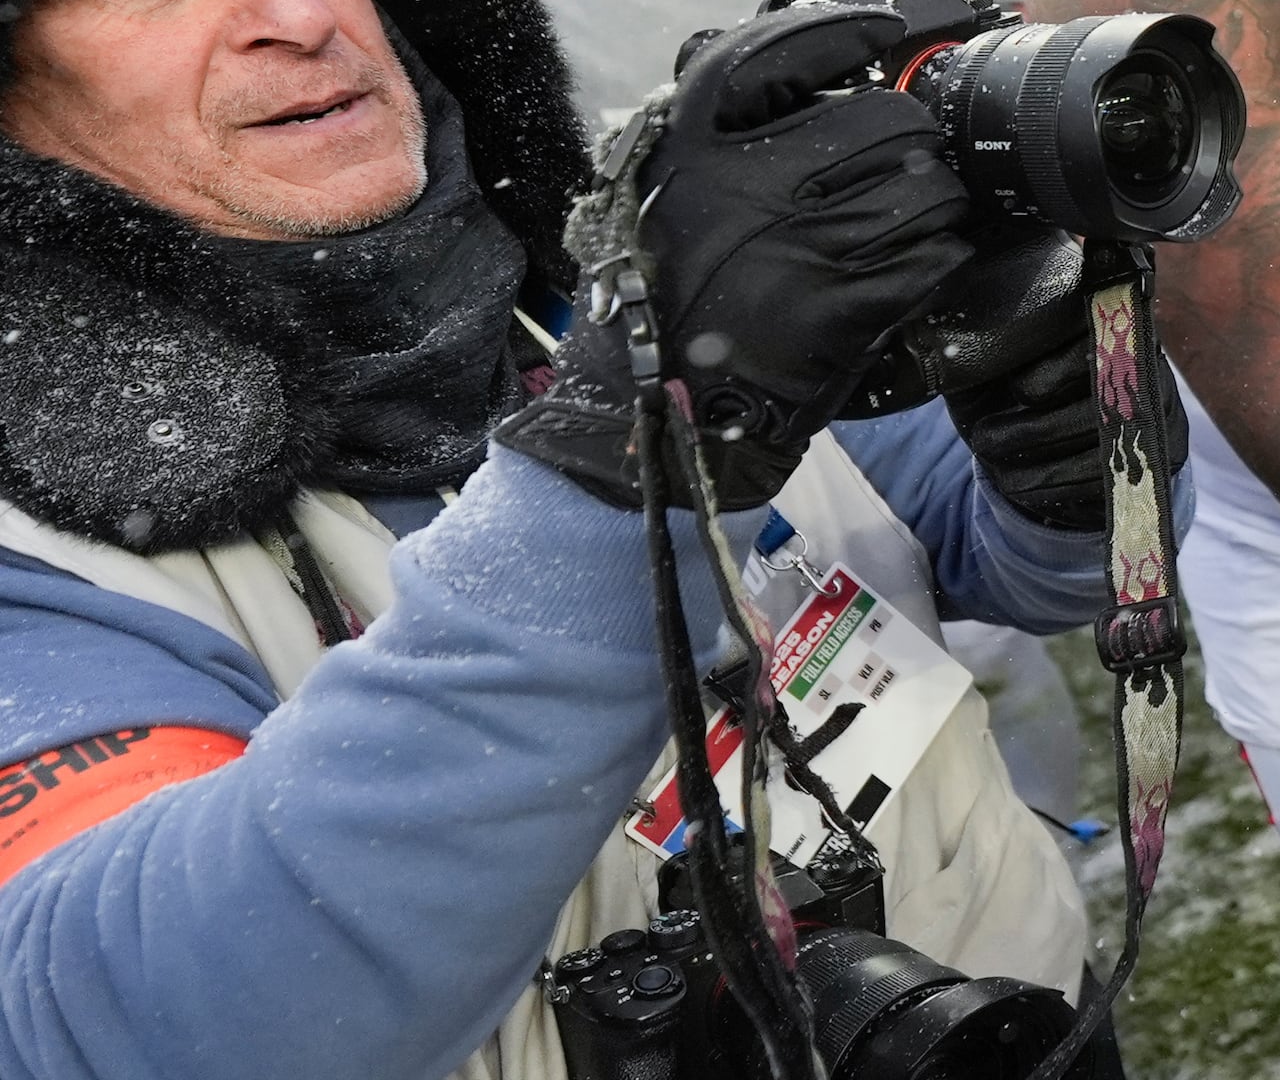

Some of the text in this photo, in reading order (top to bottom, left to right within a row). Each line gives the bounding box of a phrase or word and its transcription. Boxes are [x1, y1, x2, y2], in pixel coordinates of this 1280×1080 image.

[974, 141, 1012, 151] SONY
[770, 630, 801, 677] 025
[800, 606, 863, 684] FULL FIELD ACCESS
[0, 727, 151, 818] SHIP
